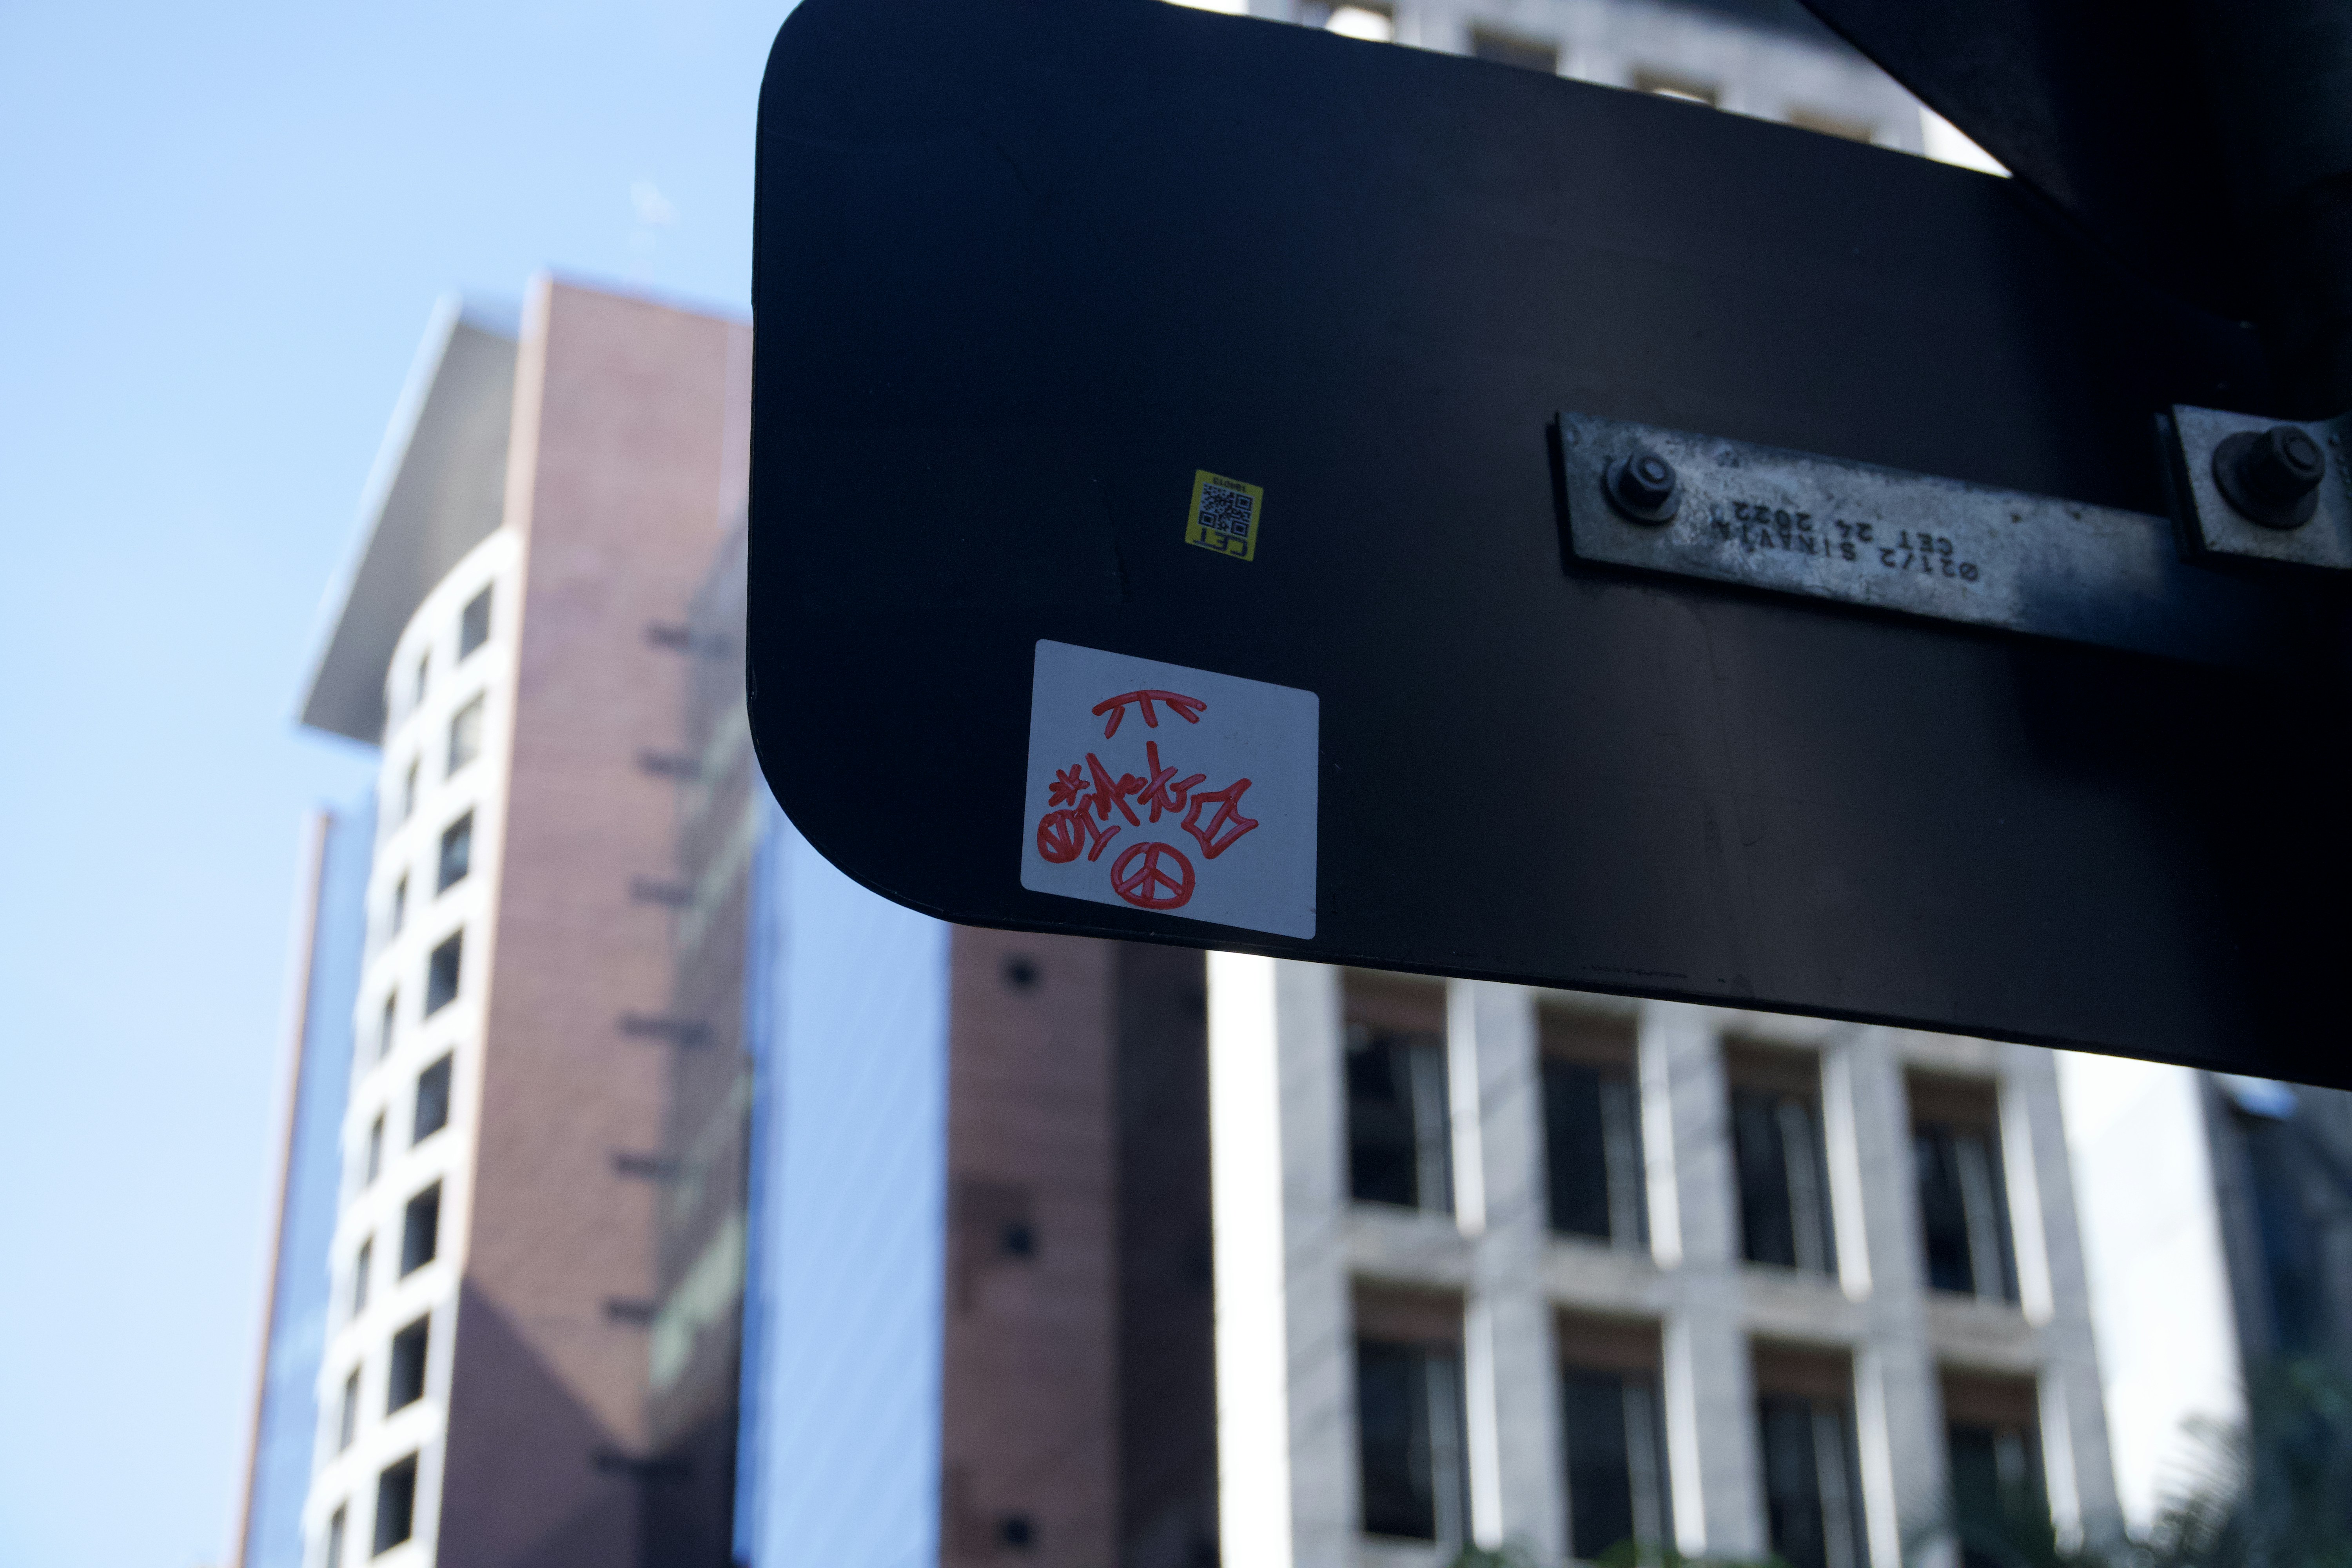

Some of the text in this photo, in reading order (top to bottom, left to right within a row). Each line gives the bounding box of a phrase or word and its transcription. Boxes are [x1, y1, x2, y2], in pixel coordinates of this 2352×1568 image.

[1193, 528, 1247, 556] CET
[1733, 501, 1953, 556] CET 24 2022
